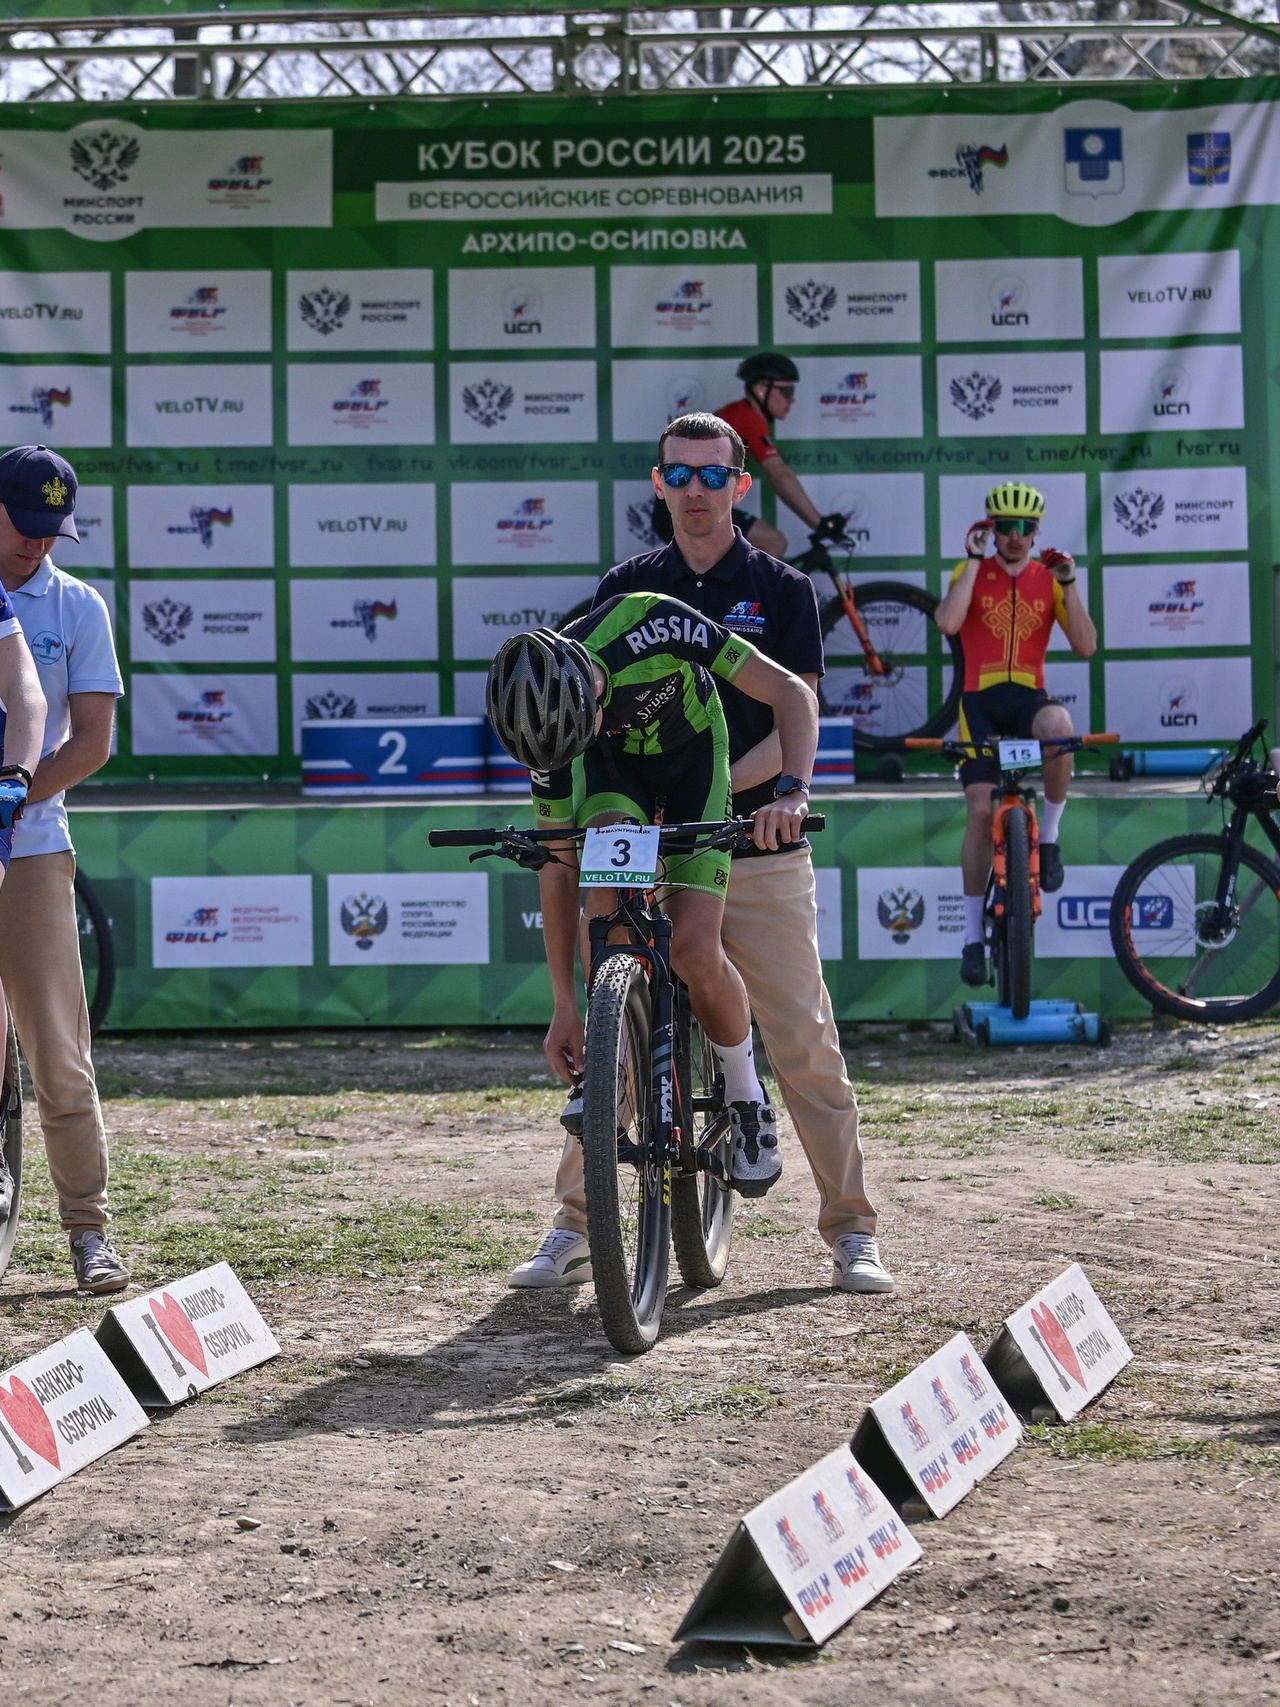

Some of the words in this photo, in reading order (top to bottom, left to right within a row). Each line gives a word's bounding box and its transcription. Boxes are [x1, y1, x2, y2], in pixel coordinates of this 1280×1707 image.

[419, 140, 541, 171] КУБОК
[554, 137, 711, 168] РОССИИ
[723, 135, 807, 164] 2025
[63, 196, 144, 209] МИНСПОРТ
[408, 186, 610, 210] ВСЕРОССИЙСКИЕ
[616, 185, 803, 207] СОРЕВНОВАНИЯ
[73, 213, 135, 225] РОССИИ
[462, 229, 747, 254] АРХИПО-ОСИПОВКА
[848, 293, 907, 304] МИНСПОРТ
[361, 301, 421, 311] МИНСПОРТ
[848, 306, 894, 316] РОССИИ
[361, 313, 407, 323] РОССИИ
[1012, 384, 1073, 395] МИНСПОРТ
[524, 393, 584, 403] МИНСПОРТ
[1012, 398, 1059, 407] РОССИИ
[524, 405, 571, 415] РОССИИ
[1026, 443, 1152, 463] t.me/fvsr_ru
[1177, 439, 1240, 457] fvsr.ru
[449, 451, 604, 471] vk.com/fvsr_ru
[784, 451, 838, 467] vsr.ru
[853, 445, 1009, 466] vk.com/fvsr_ru
[368, 454, 433, 471] fvsr.ru
[1175, 501, 1234, 511] МИНСПОРТ
[1175, 513, 1220, 523] РОССИИ
[203, 612, 263, 622] МИНСПОРТ
[203, 625, 250, 634] РОССИИ
[625, 615, 709, 656] RUSSIA
[367, 705, 427, 714] МИНСПОРТ
[378, 731, 408, 774] 2
[1009, 749, 1032, 761] 15
[539, 802, 551, 811] FAT
[539, 809, 552, 818] CAT
[610, 839, 631, 867] 3
[585, 872, 651, 883] VELOTV.RU
[715, 868, 728, 878] FAT
[401, 900, 467, 909] МИНИСТЕРСТВО
[937, 905, 965, 913] СПОРТ
[401, 919, 457, 928] РОССИЙСКОЙ
[401, 930, 452, 939] ФЕДЕРАЦИИ
[660, 1075, 673, 1124] FOX
[182, 1286, 225, 1322] ARKHIPO-
[1054, 1291, 1087, 1332] ARKHIPO-
[204, 1320, 254, 1359] OSIPOVKA
[1075, 1328, 1113, 1370] OSIPOVKA
[31, 1358, 84, 1406] ARKHIPO-
[56, 1394, 117, 1445] OSIPOVKA
